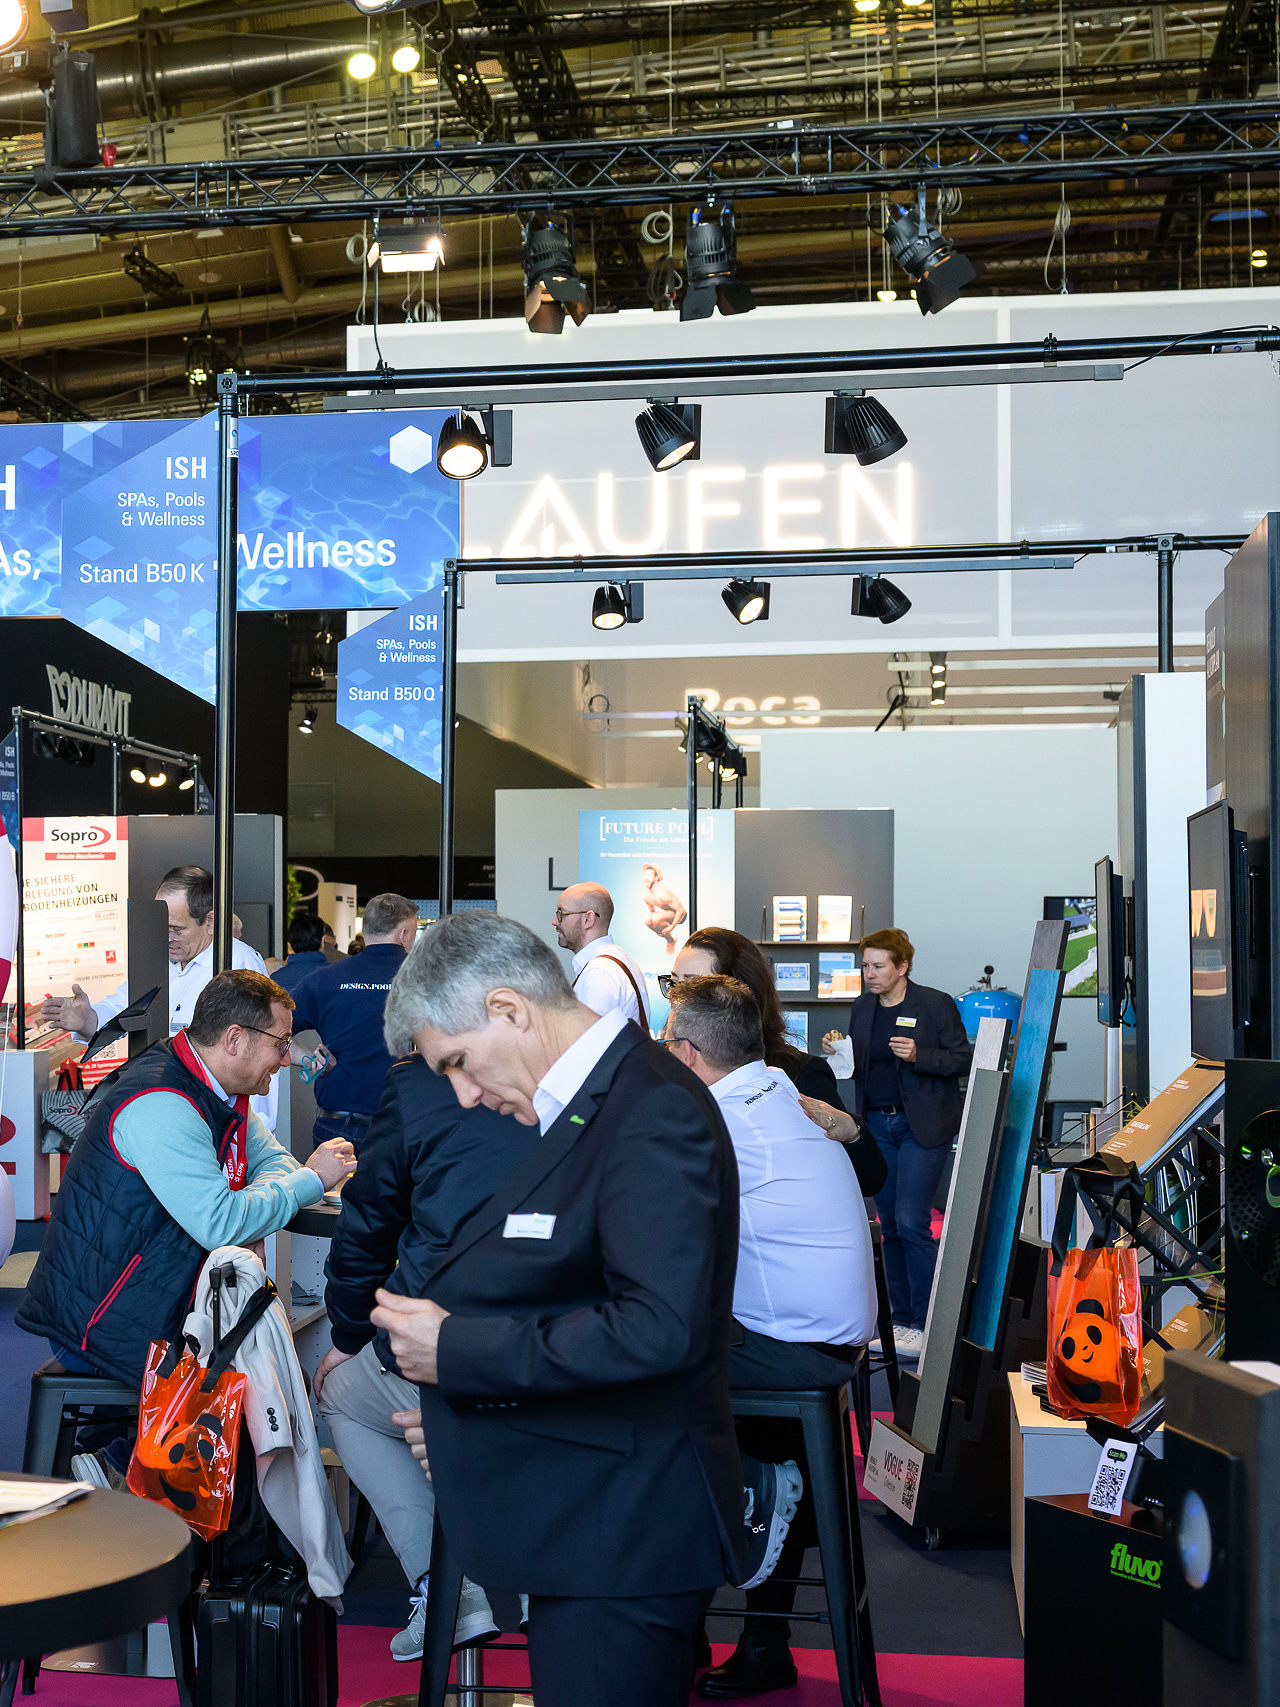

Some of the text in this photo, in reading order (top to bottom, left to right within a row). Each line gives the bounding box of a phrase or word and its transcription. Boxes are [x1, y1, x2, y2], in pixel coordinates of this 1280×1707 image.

[166, 456, 207, 479] ISH
[117, 492, 206, 509] SPAs, Pools
[121, 511, 205, 526] & Wellness
[79, 563, 205, 583] Stand B50 K
[409, 615, 438, 631] ISH
[376, 639, 437, 650] SPAs, Pools
[379, 652, 436, 662] & Wellness
[348, 687, 435, 701] Stand B50 Q
[668, 822, 709, 834] POL
[51, 829, 98, 844] Sopro
[34, 873, 76, 886] SICHERE
[76, 883, 98, 894] VON
[23, 893, 118, 912] BODENHEIZUNGEN
[49, 1106, 73, 1116] Sopro
[1108, 1449, 1119, 1459] Scan
[883, 1449, 904, 1481] VOGUE
[1110, 1543, 1161, 1581] fluvo
